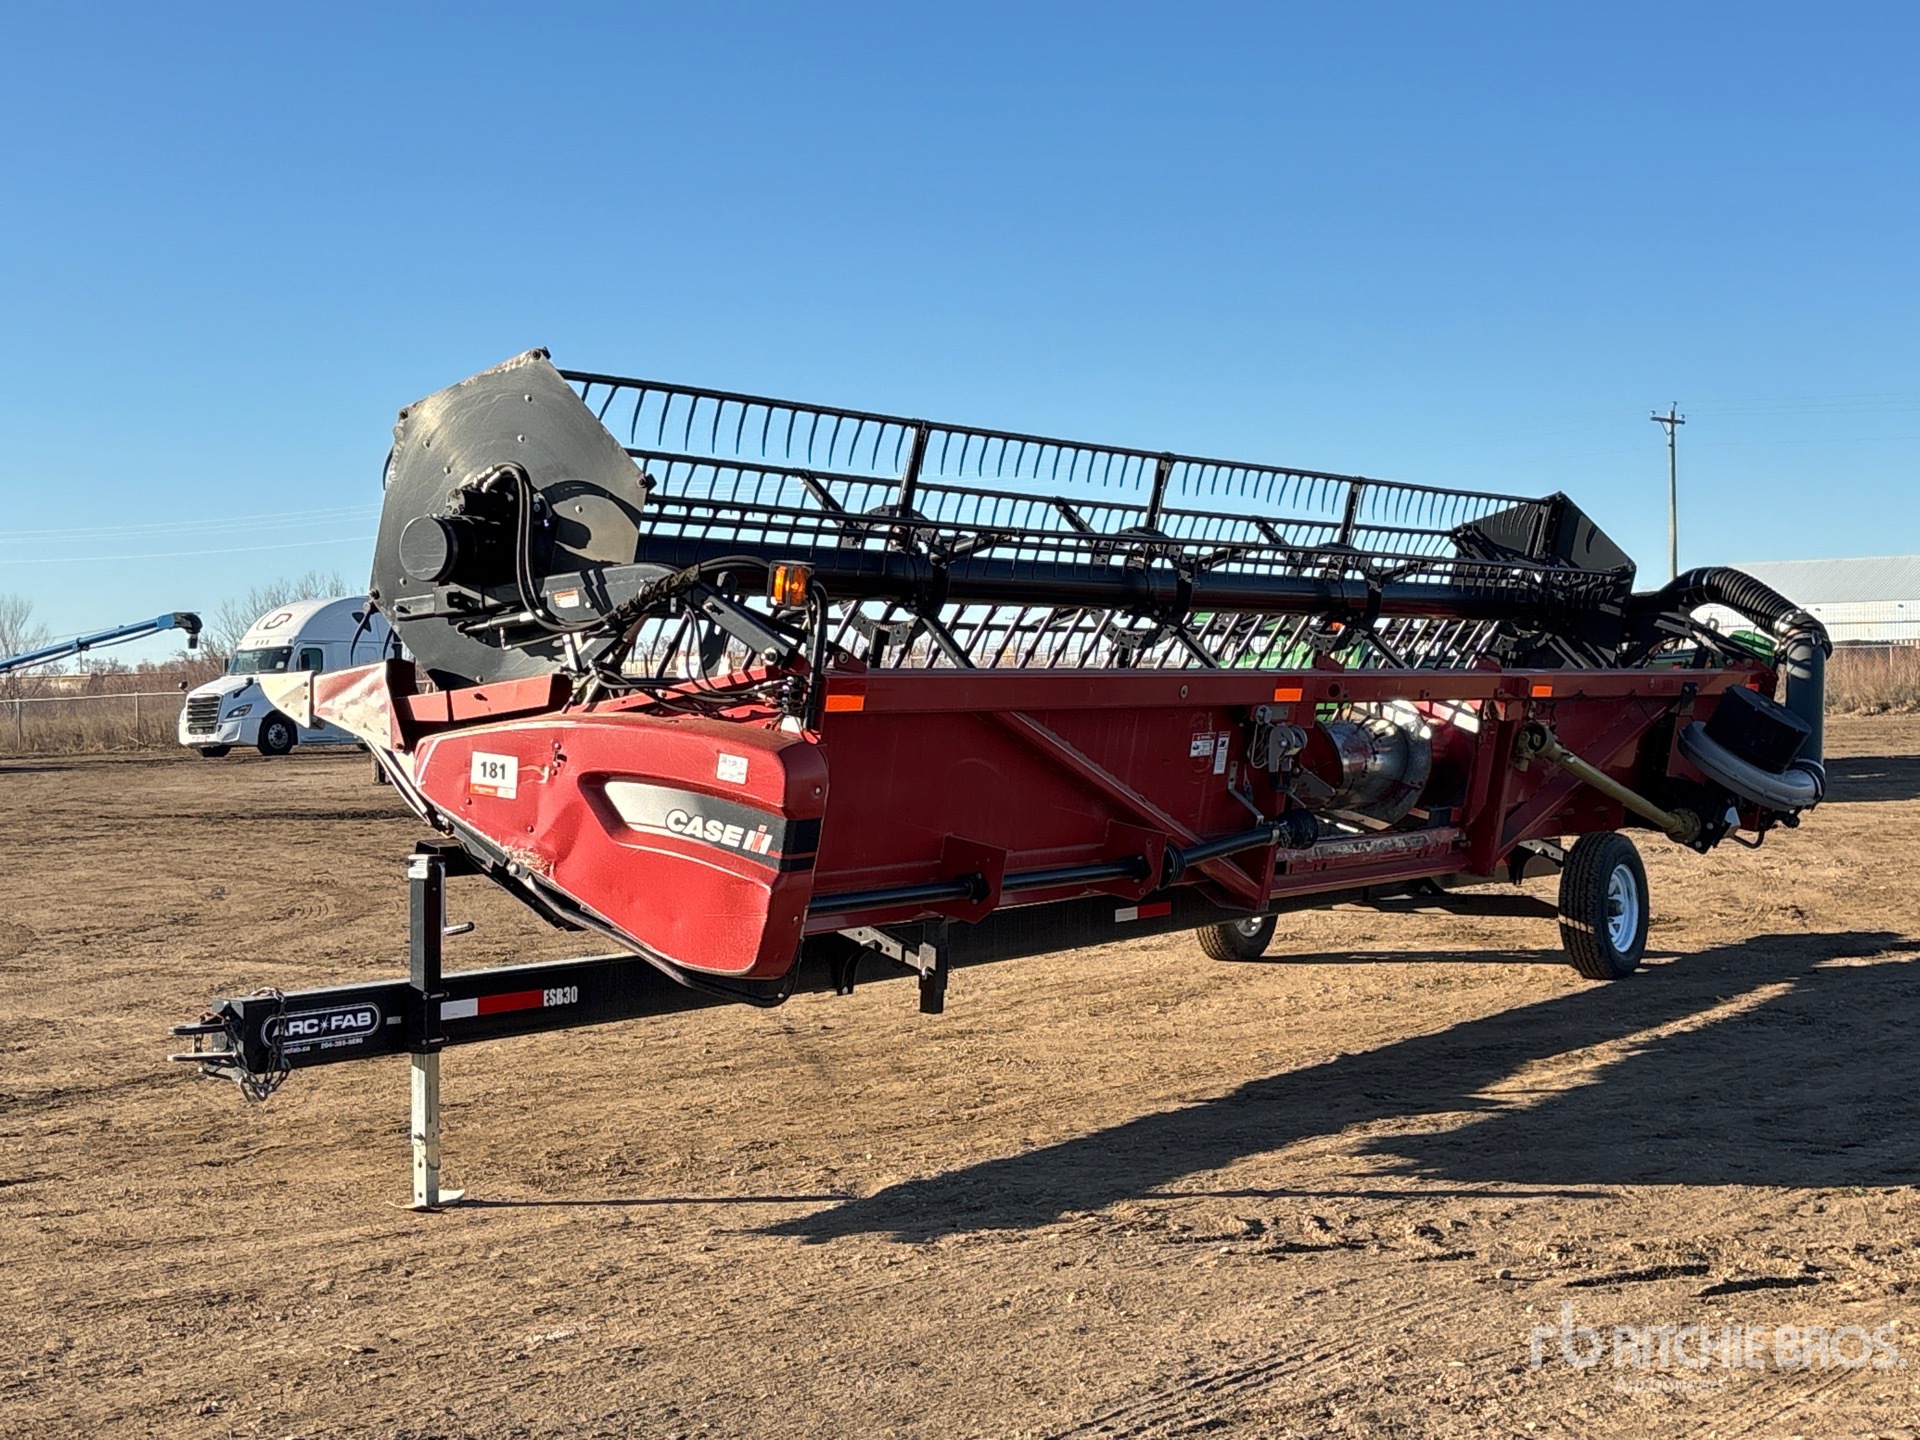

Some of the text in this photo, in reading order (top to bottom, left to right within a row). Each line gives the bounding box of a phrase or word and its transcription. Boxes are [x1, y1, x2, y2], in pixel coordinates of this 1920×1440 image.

[480, 761, 506, 780] 181
[665, 808, 745, 848] CASE
[543, 985, 579, 1007] ESB30
[330, 1011, 372, 1031] FAB
